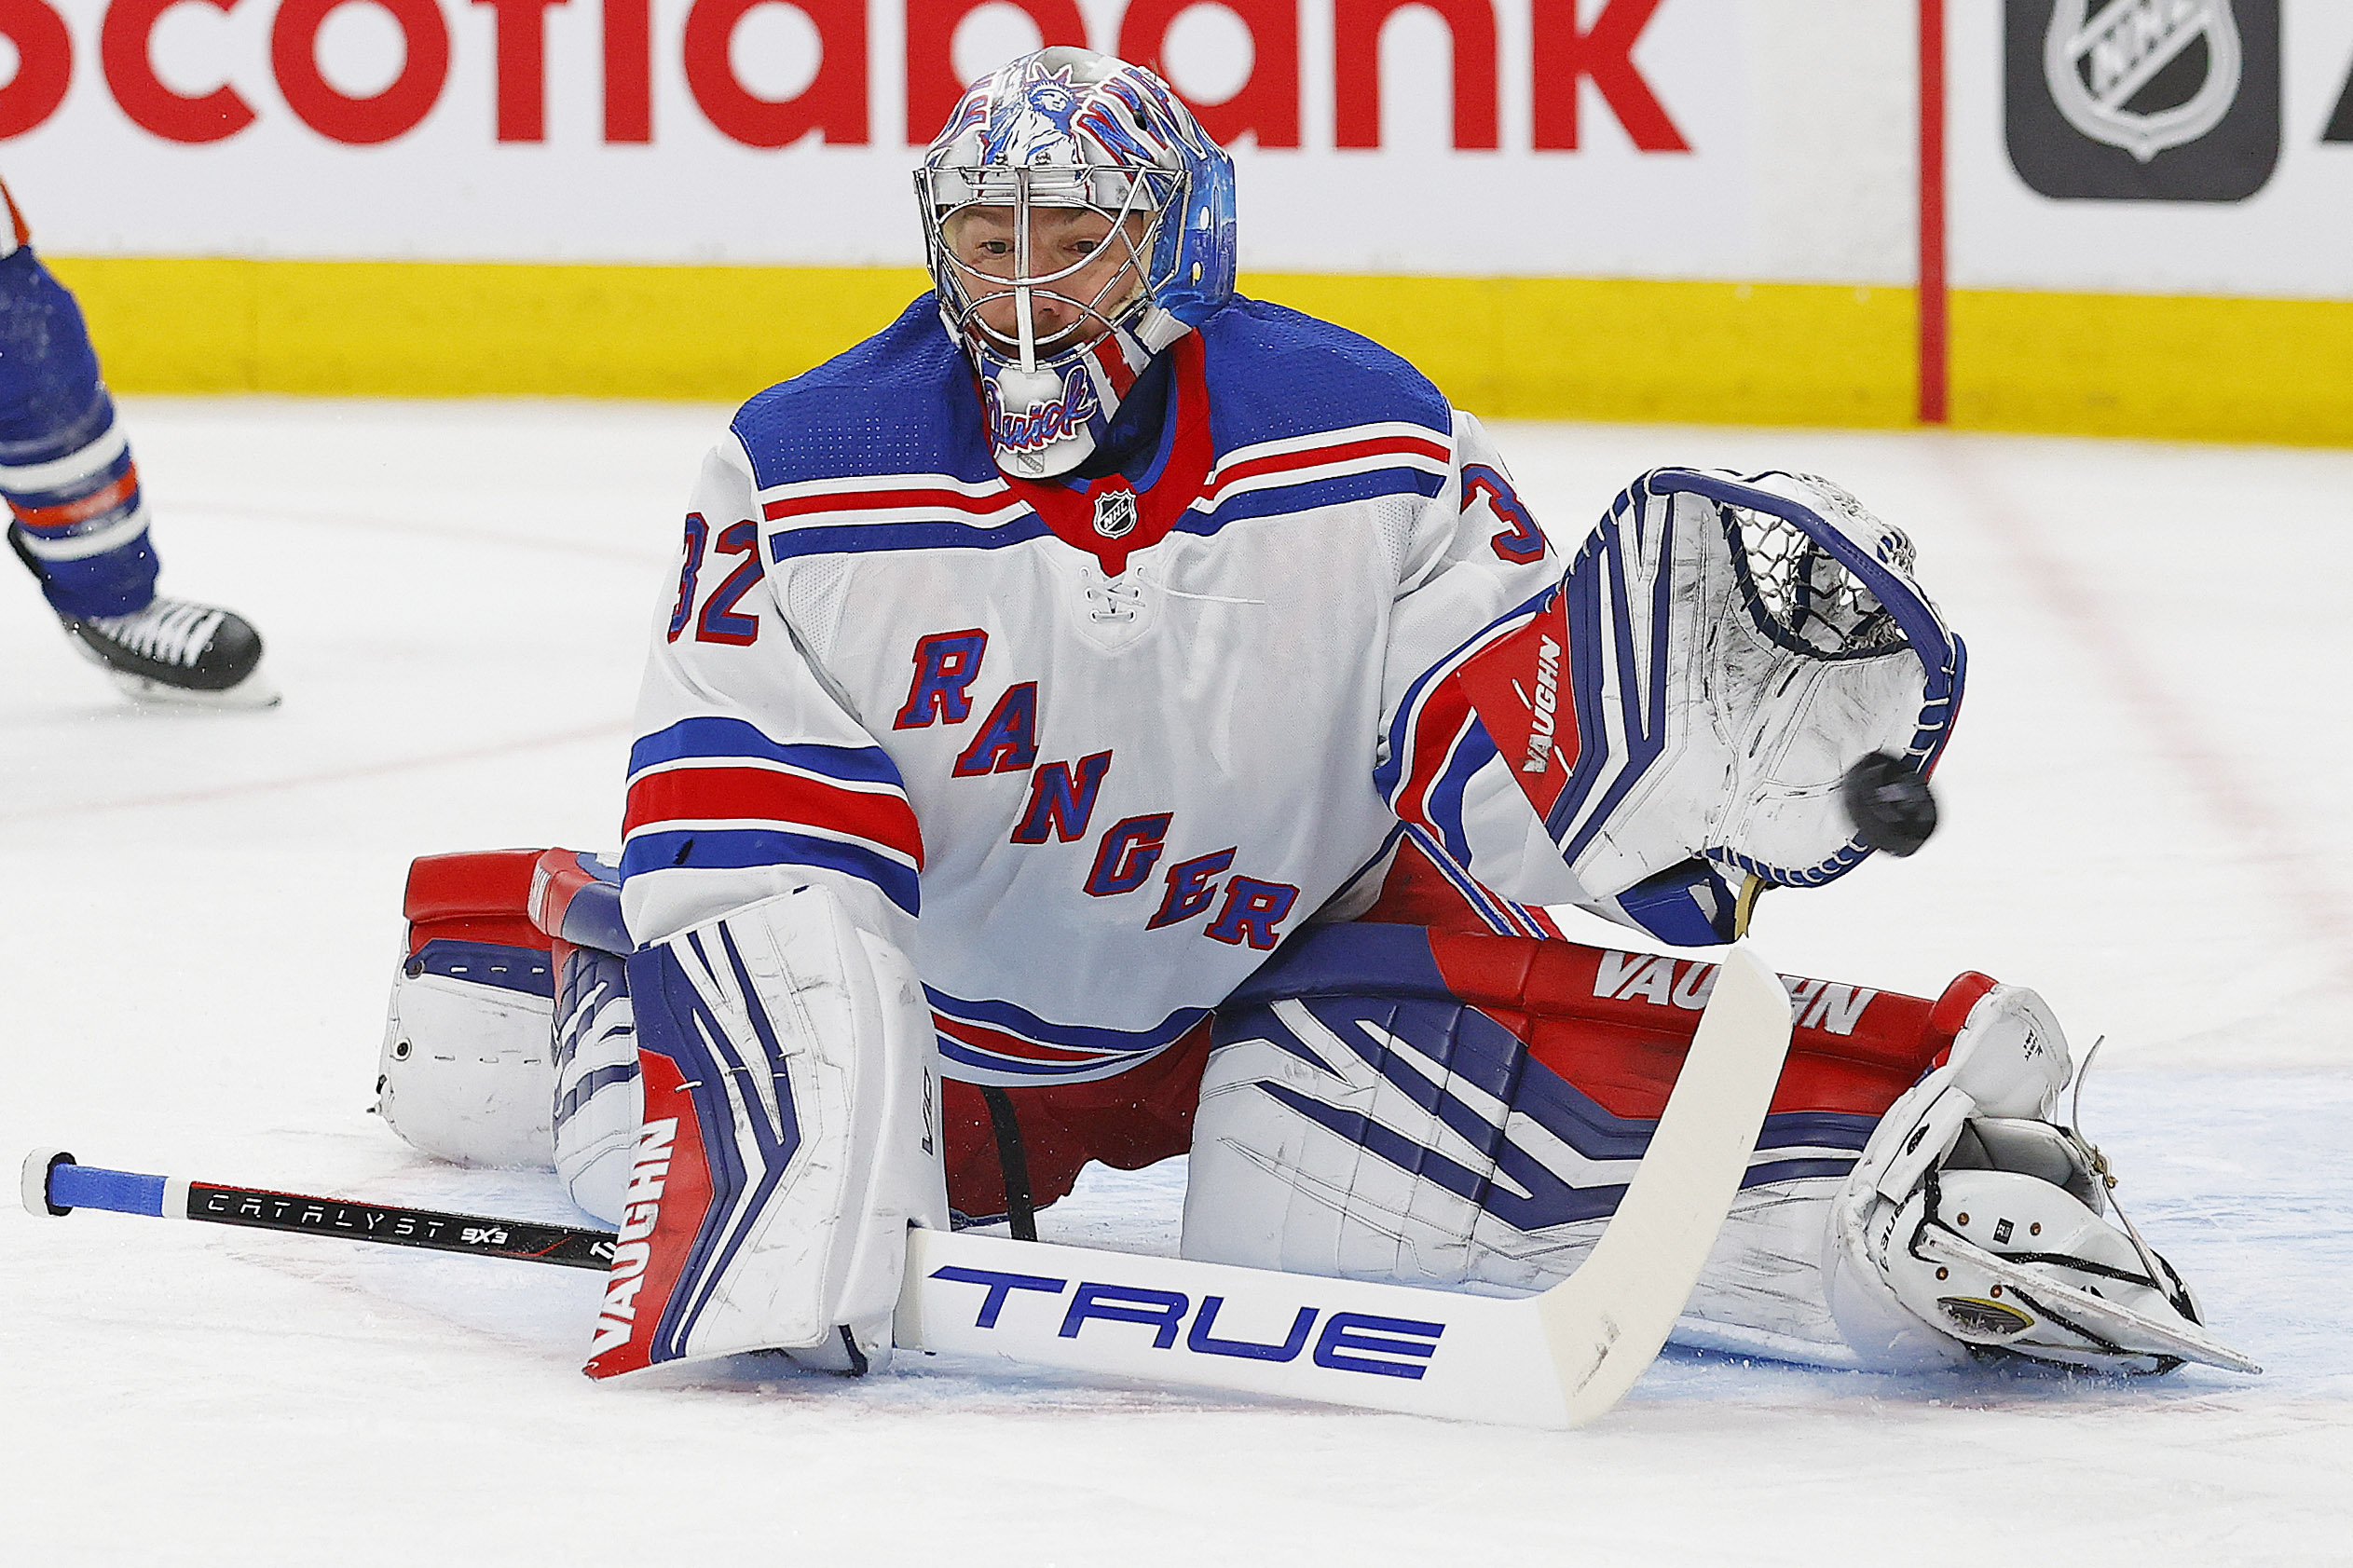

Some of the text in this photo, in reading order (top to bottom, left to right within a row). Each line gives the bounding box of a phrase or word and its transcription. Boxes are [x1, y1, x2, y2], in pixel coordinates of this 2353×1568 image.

[0, 0, 1693, 149] cotiabank
[983, 364, 1098, 454] Quick
[1103, 502, 1128, 528] NHL
[667, 511, 765, 647] 32
[1523, 634, 1561, 773] VAUGHN
[893, 628, 1300, 951] RANGER
[1593, 949, 1879, 1036] VAUHN
[208, 1194, 445, 1238] CATALYST
[588, 1117, 678, 1361] VAUGHN
[927, 1265, 1446, 1380] TRUE
